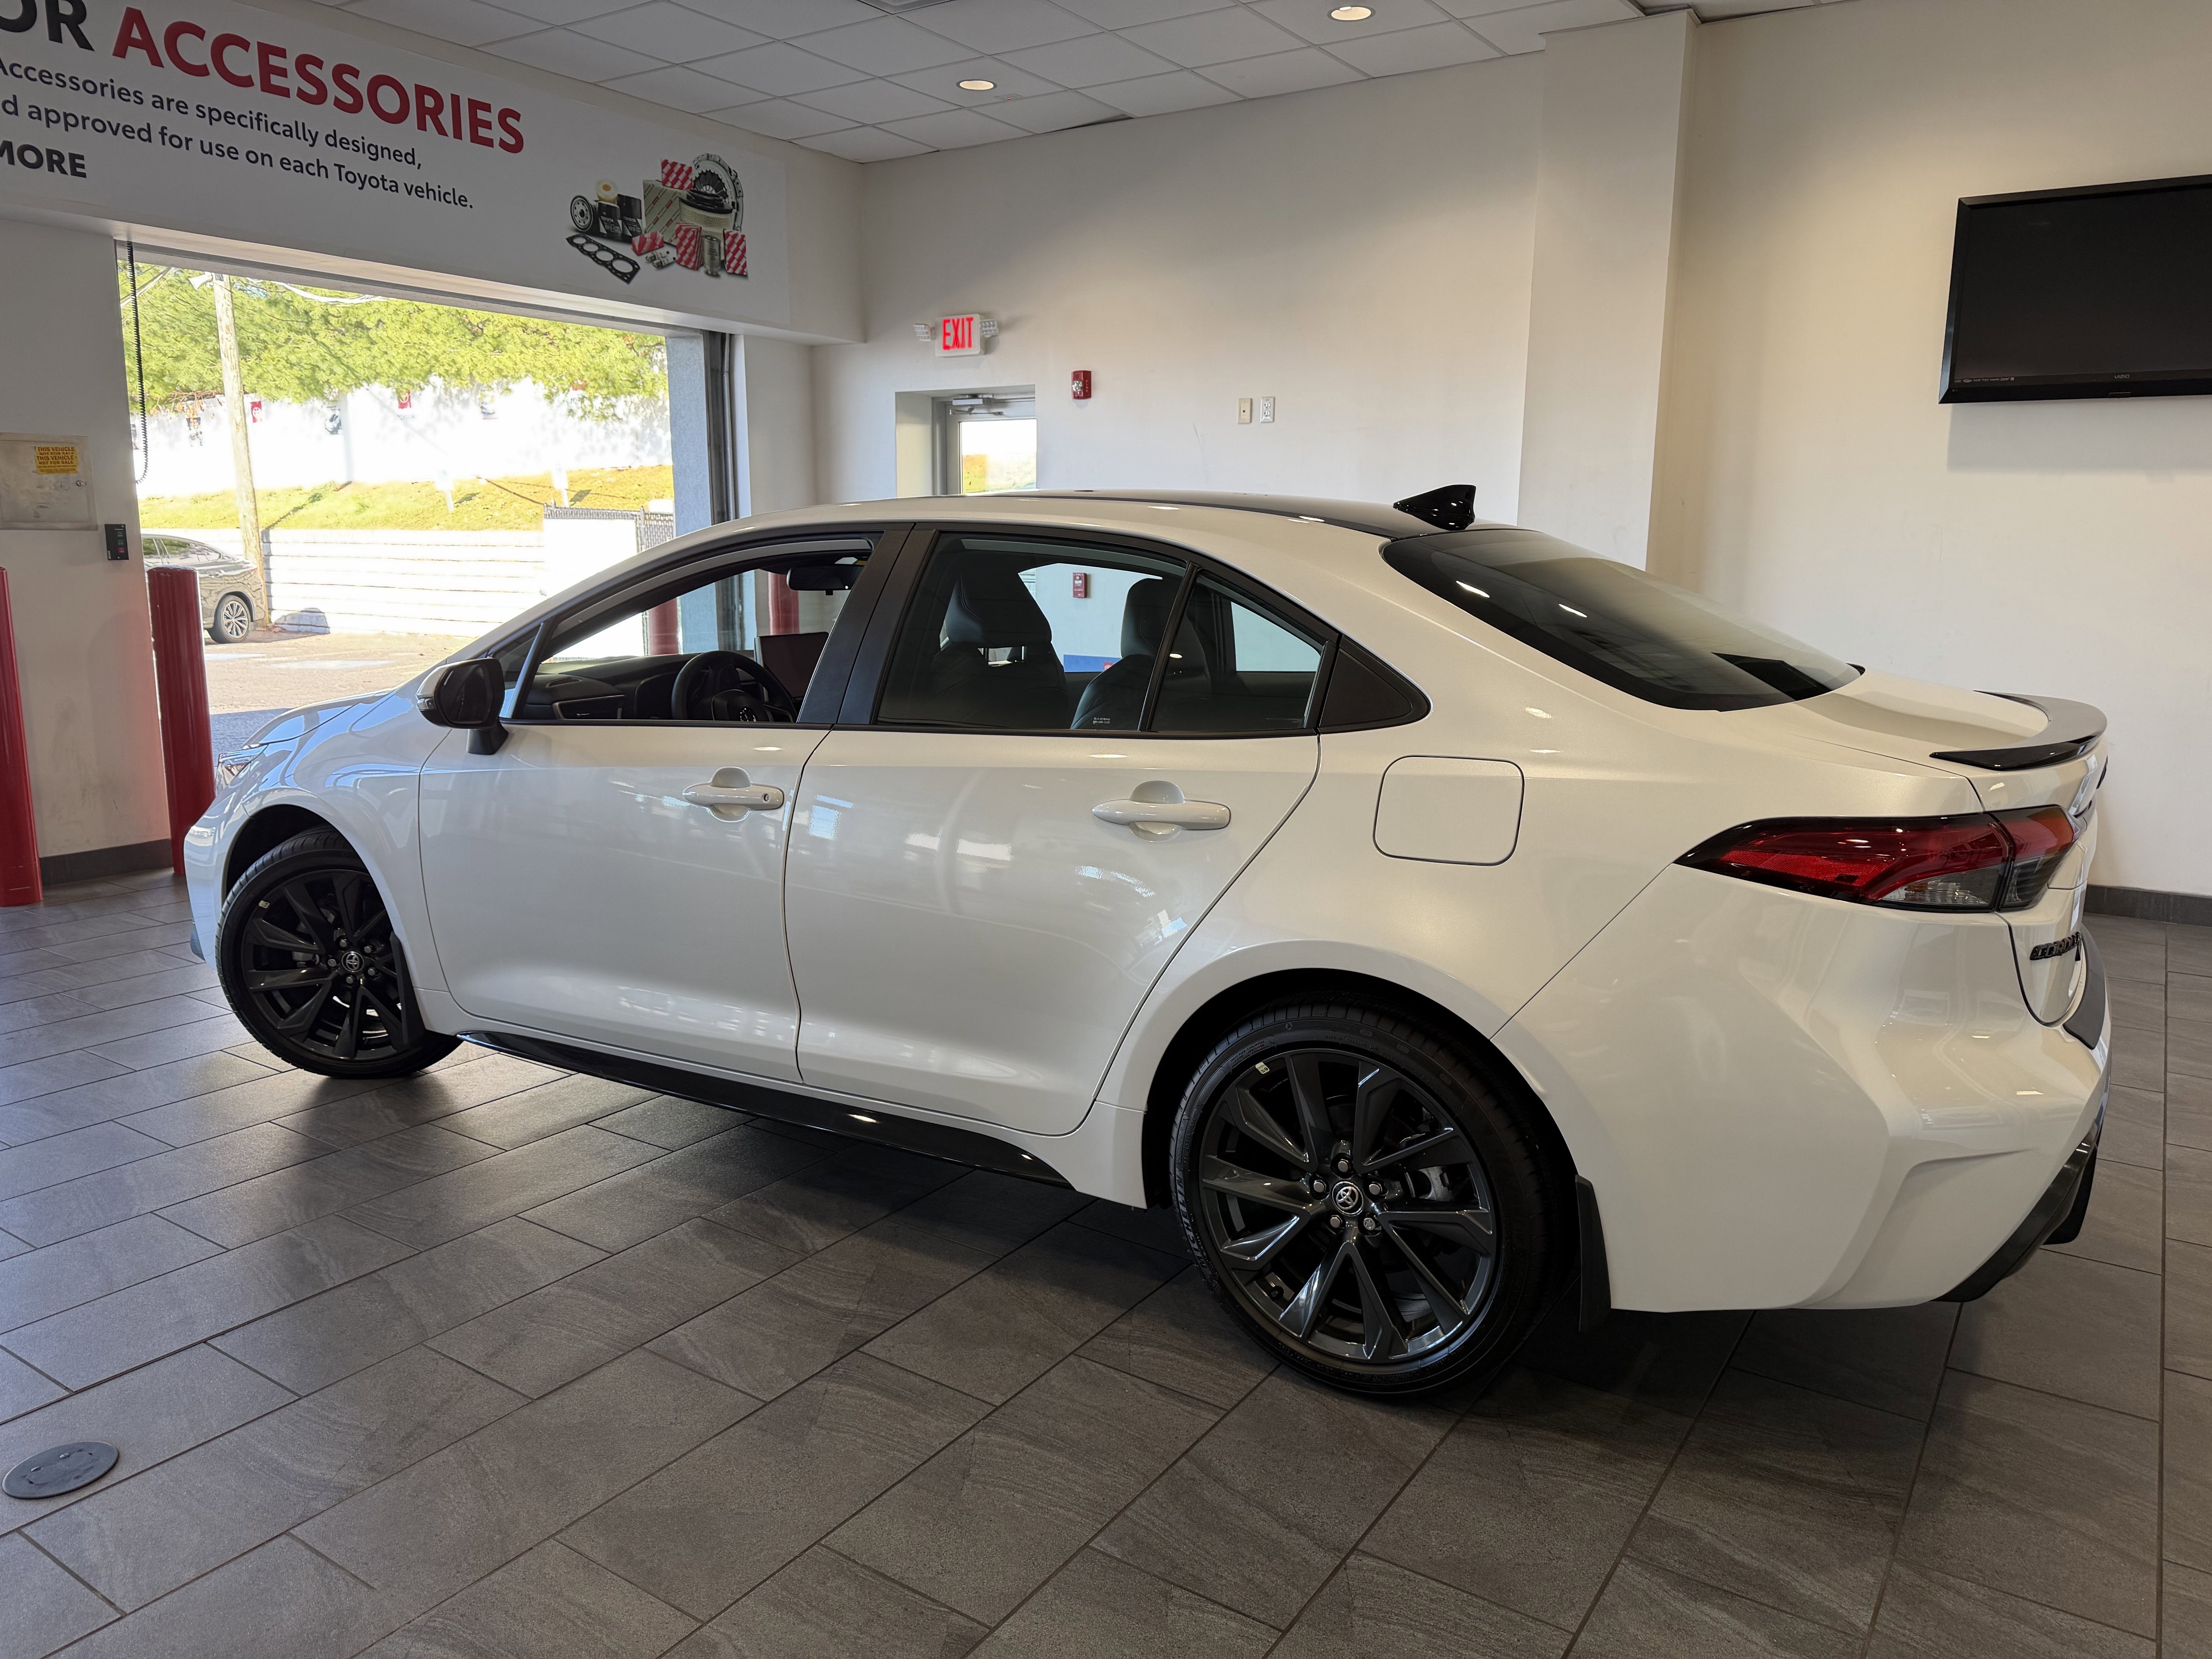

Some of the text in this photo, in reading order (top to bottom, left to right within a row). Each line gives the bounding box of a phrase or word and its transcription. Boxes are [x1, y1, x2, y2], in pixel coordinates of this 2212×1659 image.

[112, 6, 524, 154] ACCESSORIES
[28, 105, 152, 143] approved
[159, 126, 193, 151] for
[200, 139, 239, 160] use
[245, 150, 273, 168] on
[280, 156, 329, 179] each
[333, 163, 399, 194] Toyota
[403, 180, 473, 210] vehicle.
[151, 94, 189, 115] are
[196, 104, 319, 148] specifically
[325, 129, 421, 170] designed,
[943, 317, 974, 350] EXIT
[1176, 1174, 1207, 1269] MICHELIN
